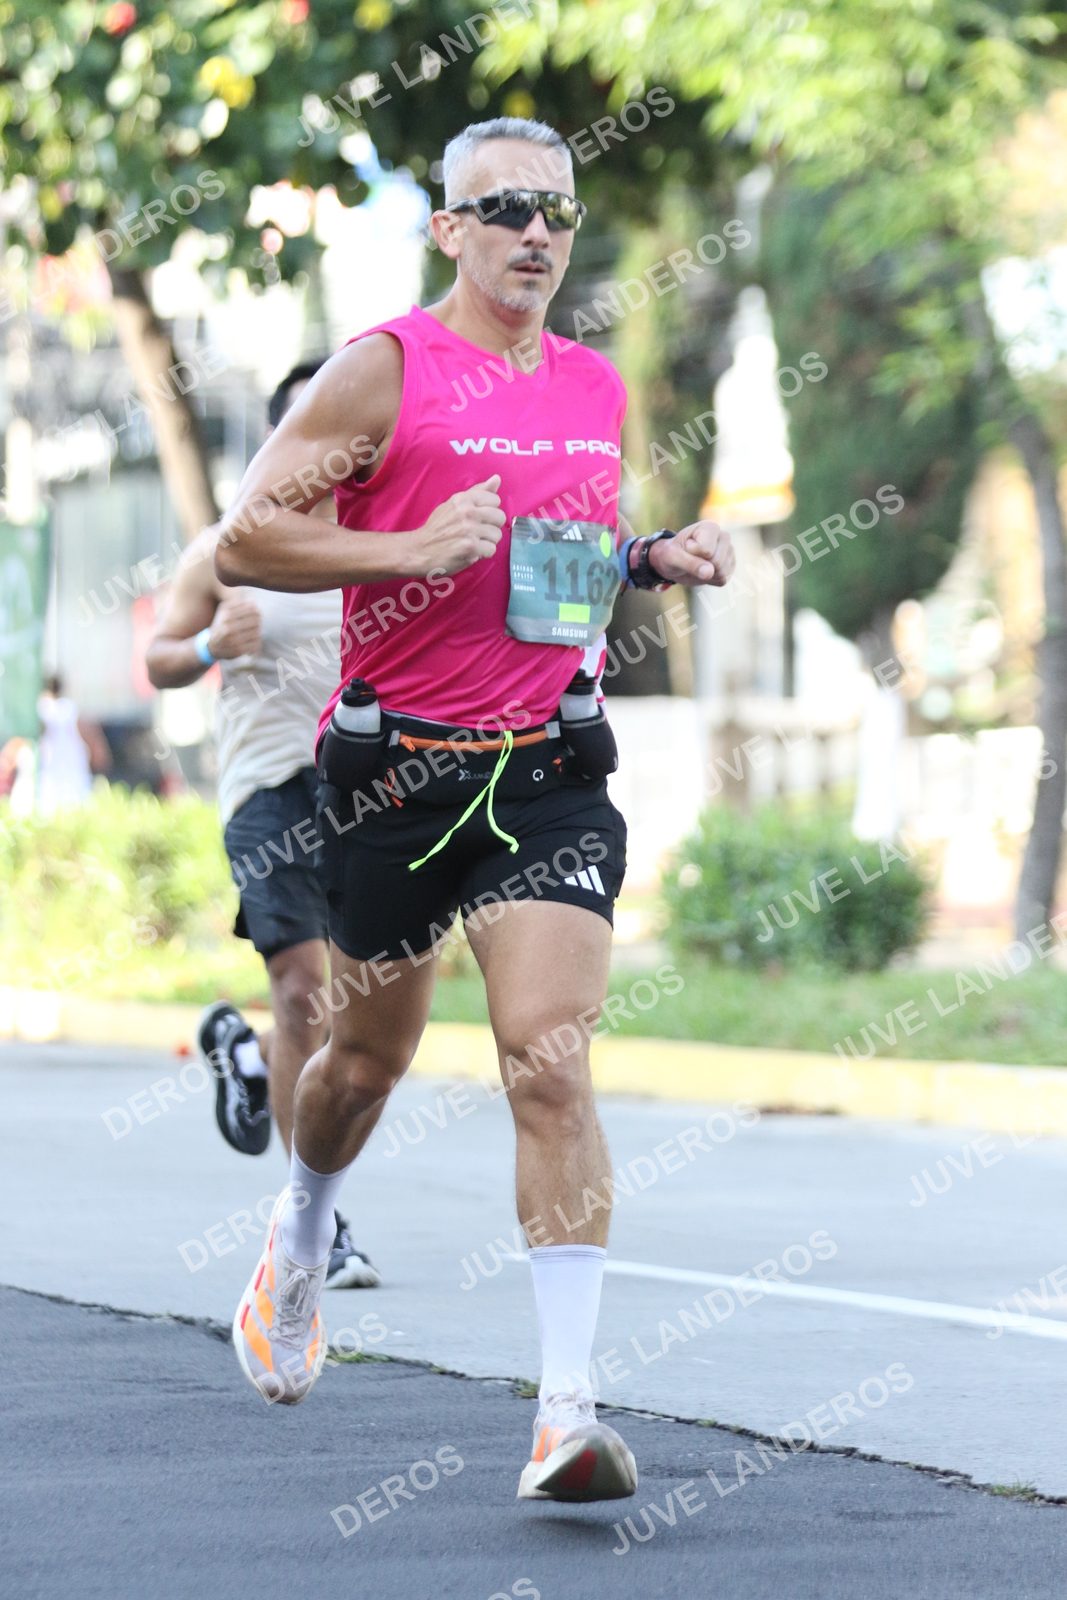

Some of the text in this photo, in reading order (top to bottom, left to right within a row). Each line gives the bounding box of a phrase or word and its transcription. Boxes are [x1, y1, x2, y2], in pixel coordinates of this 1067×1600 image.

[449, 437, 621, 459] WOLF PAC
[542, 557, 619, 606] 1162
[552, 626, 587, 638] SAMSUNG
